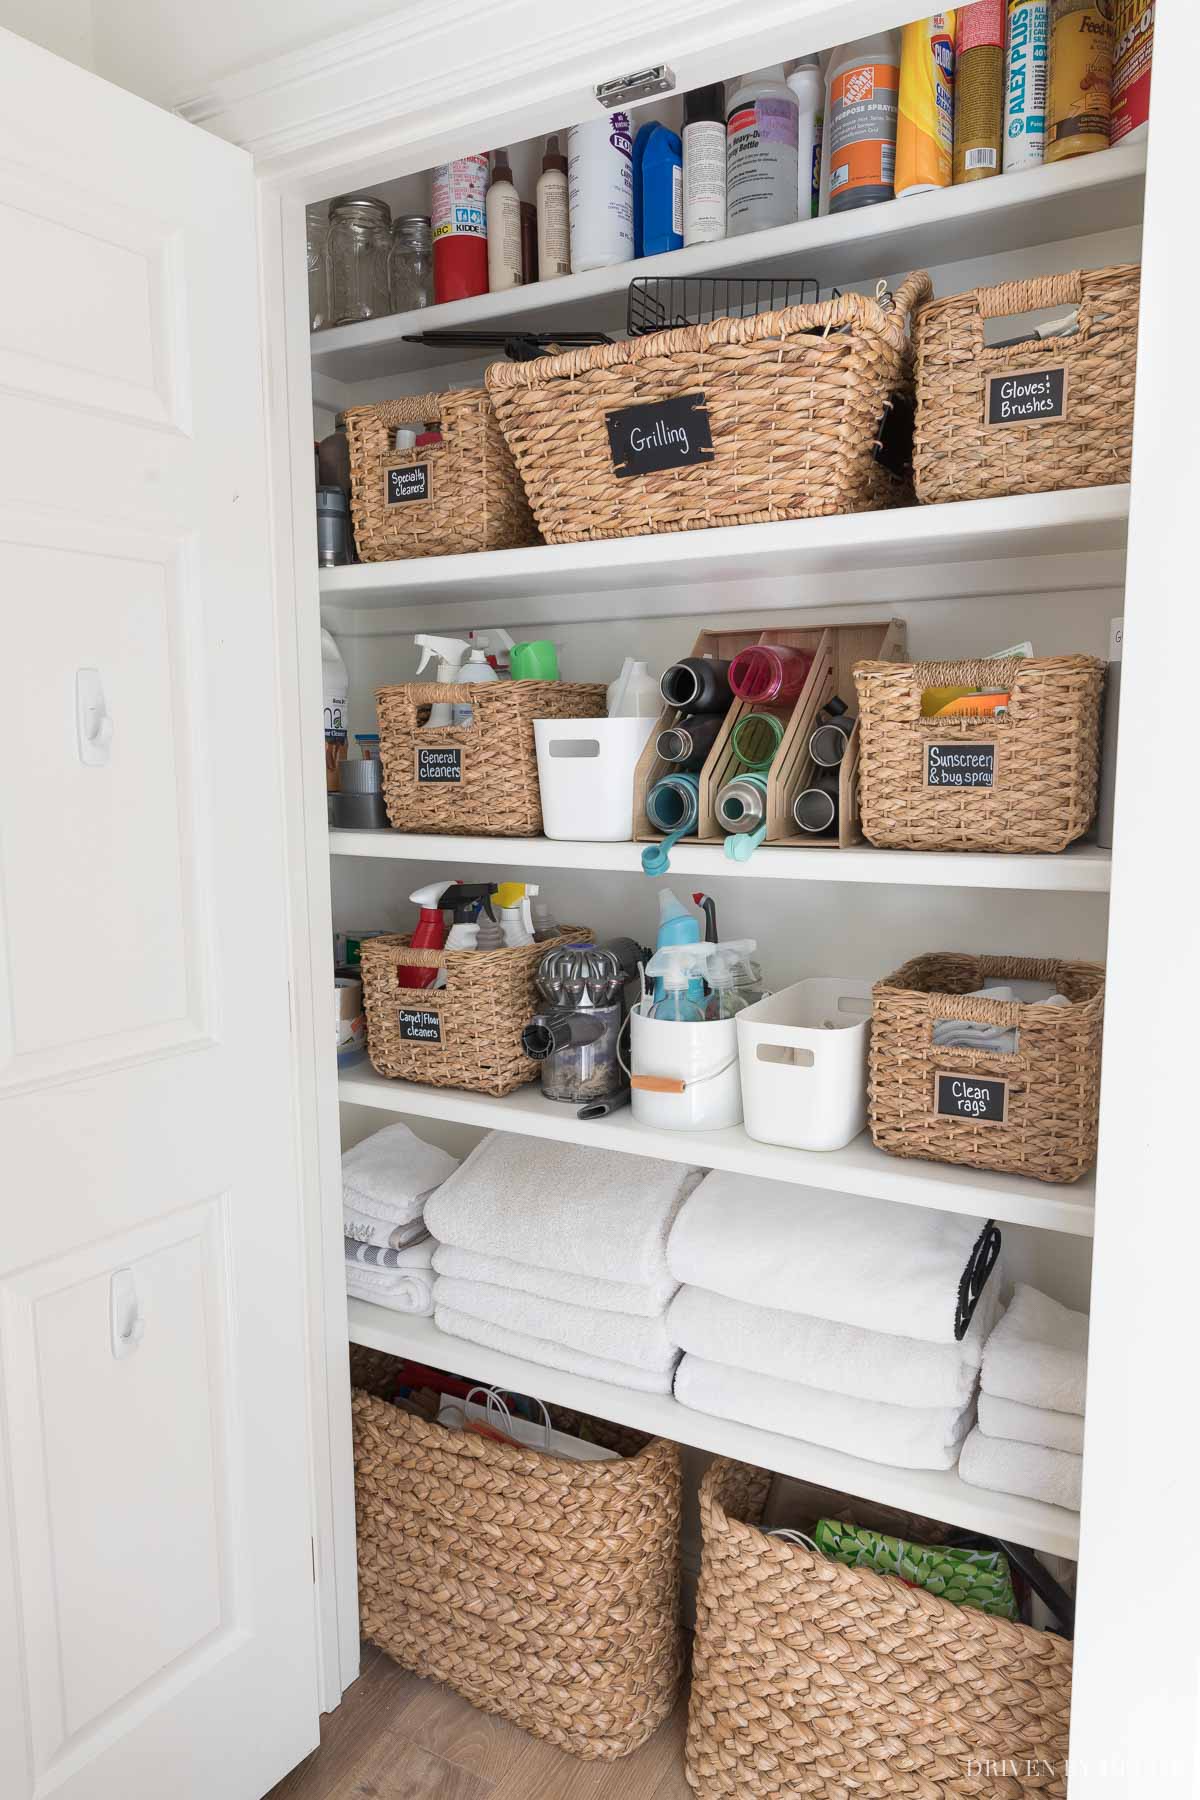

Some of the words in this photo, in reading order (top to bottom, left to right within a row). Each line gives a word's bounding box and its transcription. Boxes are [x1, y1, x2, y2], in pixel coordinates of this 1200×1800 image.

[1011, 8, 1030, 64] PLUS
[1009, 63, 1027, 115] ALEX
[456, 224, 480, 233] KIDDE
[1001, 396, 1054, 418] Brushes
[630, 420, 690, 455] Grilling
[392, 468, 425, 487] Specialty
[396, 484, 424, 497] cleaners
[420, 750, 457, 764] General
[930, 747, 994, 770] Sunscreen
[420, 763, 461, 778] cleaners
[929, 768, 940, 784] &
[941, 769, 963, 786] bug
[964, 771, 993, 788] spray
[407, 1026, 438, 1038] cleaners
[952, 1082, 990, 1101] Clean
[957, 1098, 986, 1116] rags
